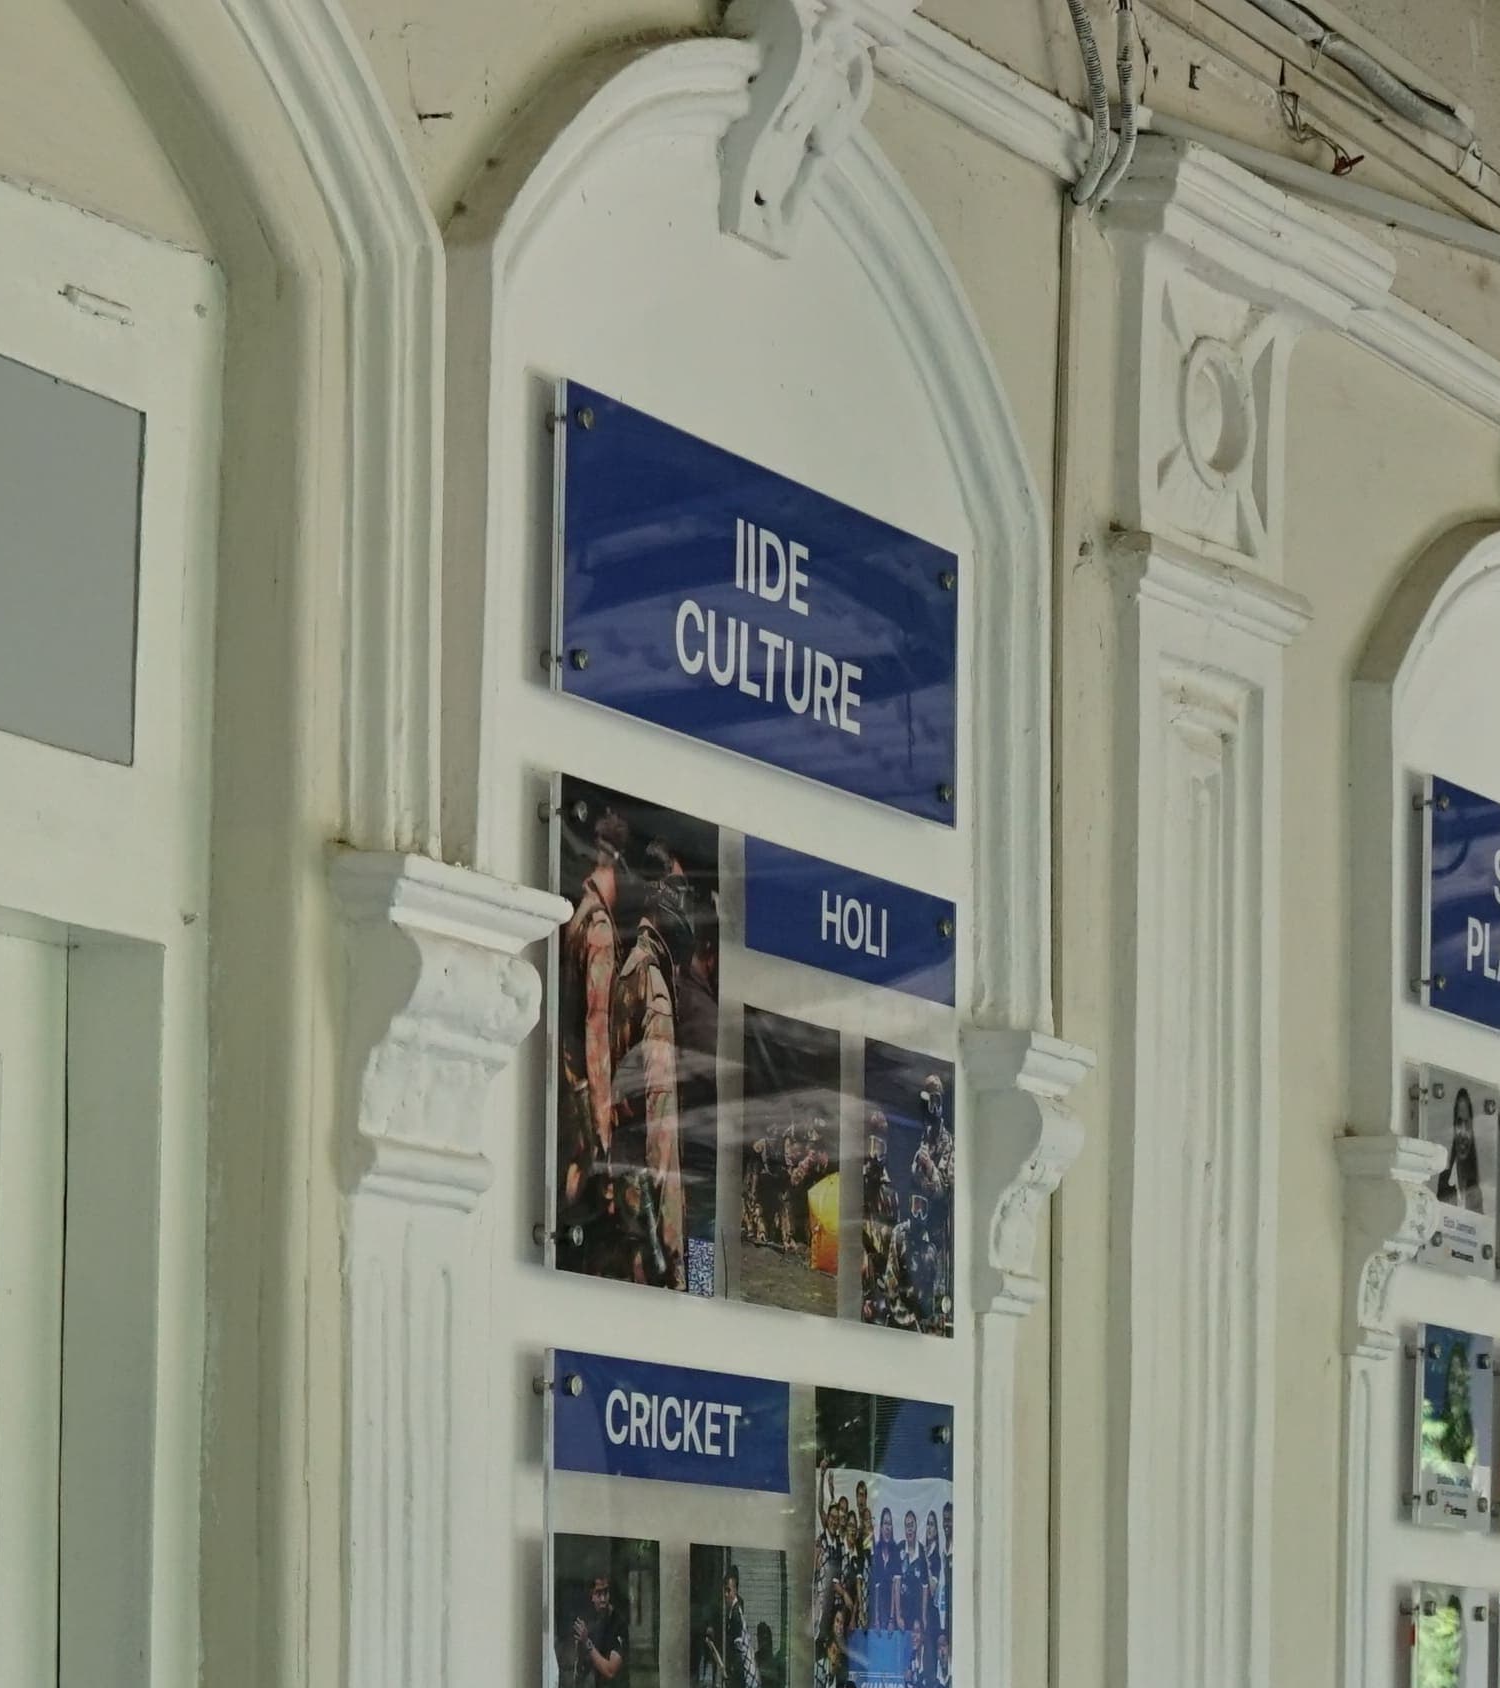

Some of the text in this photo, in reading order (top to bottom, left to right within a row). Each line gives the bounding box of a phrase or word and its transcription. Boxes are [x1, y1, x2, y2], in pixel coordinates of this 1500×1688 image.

[735, 518, 809, 617] IIDE
[675, 599, 863, 735] CULTURE
[821, 890, 889, 958] HOLI
[604, 1388, 743, 1458] CRICKET
